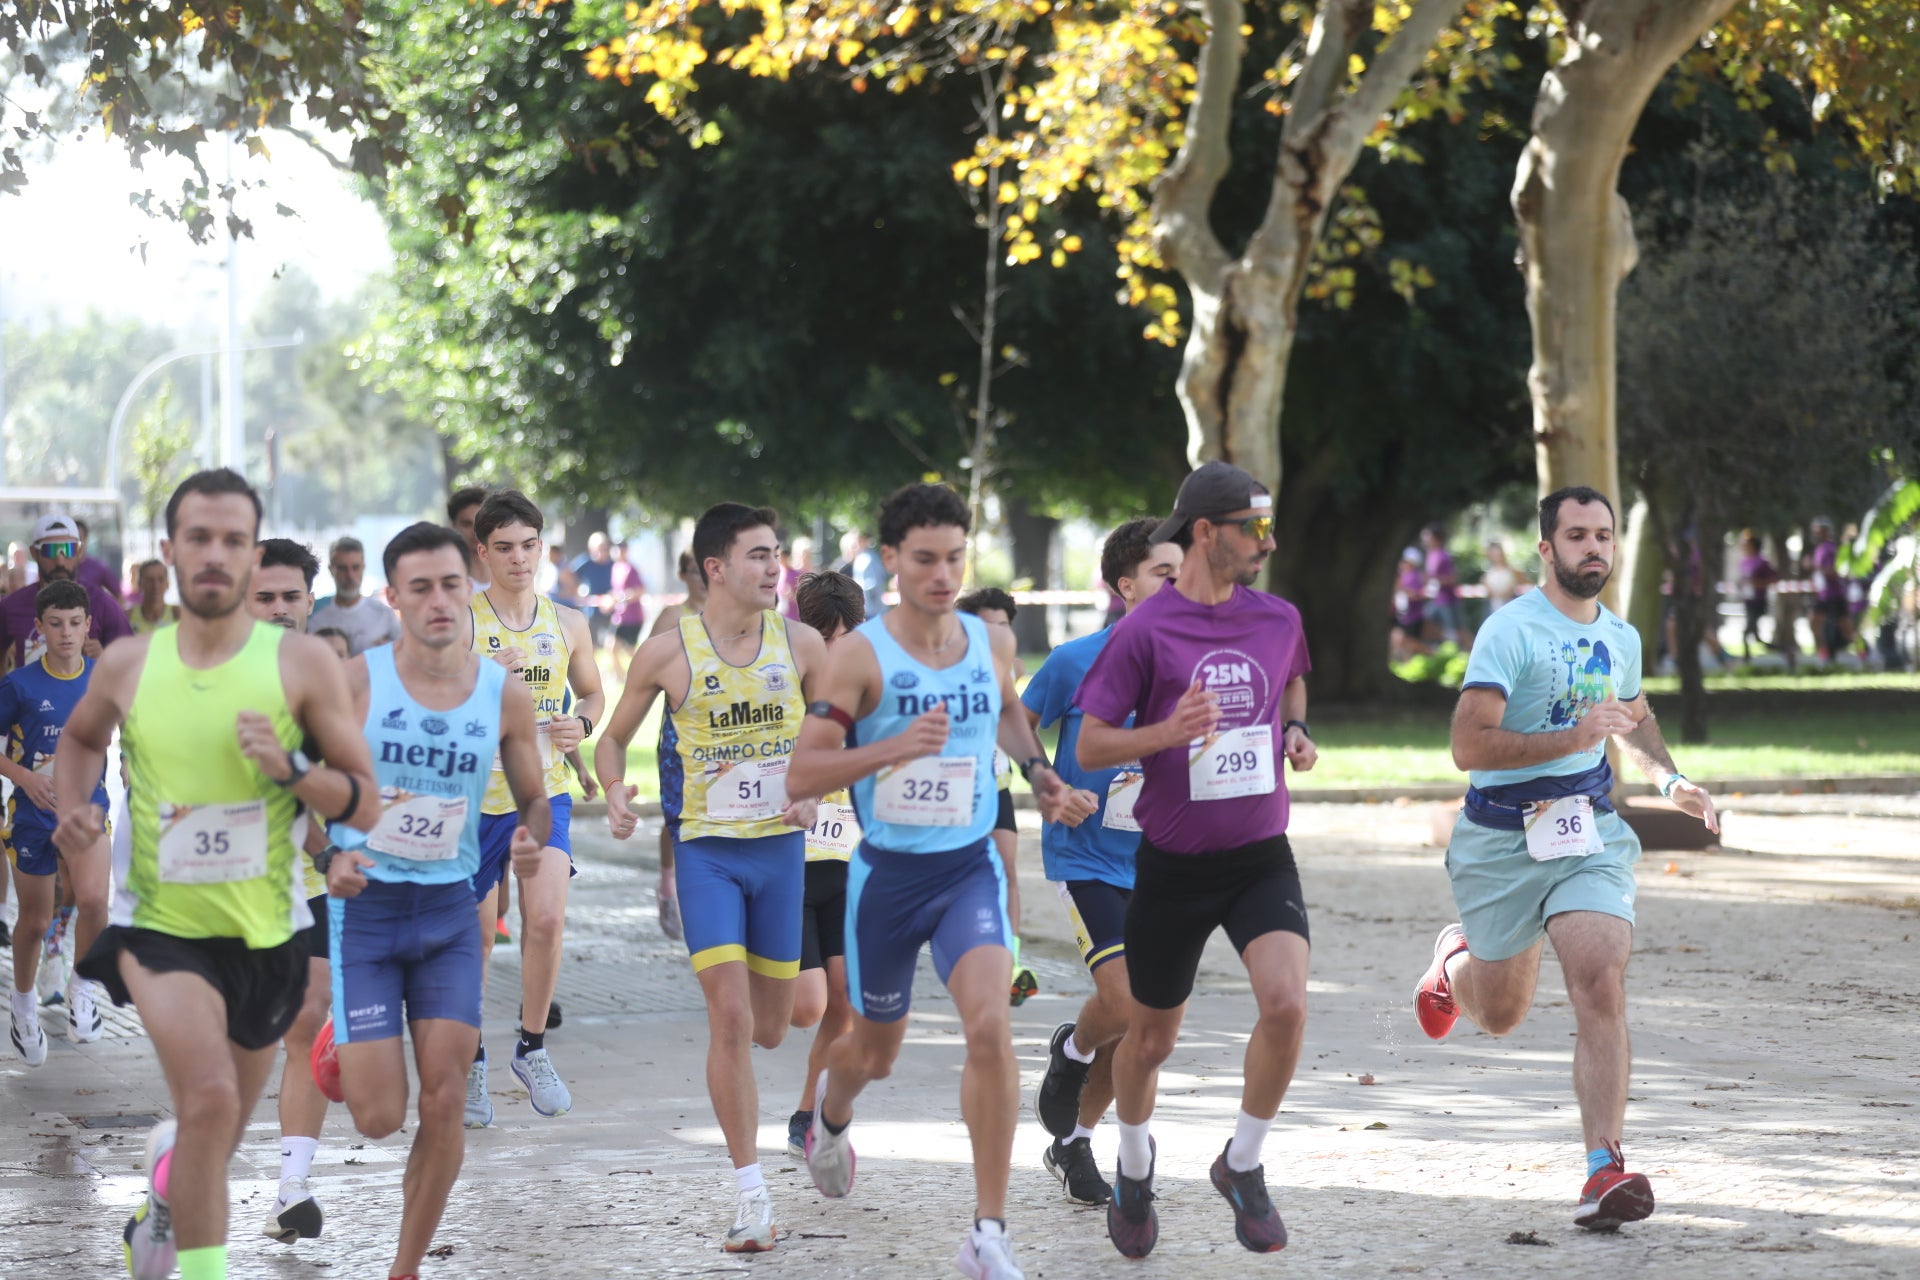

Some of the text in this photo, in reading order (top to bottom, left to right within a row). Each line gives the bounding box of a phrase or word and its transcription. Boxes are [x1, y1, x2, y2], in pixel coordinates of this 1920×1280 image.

[1203, 662, 1251, 686] 25N
[709, 701, 784, 729] LaMafia
[896, 683, 990, 723] nerja
[379, 740, 478, 778] nerja
[692, 735, 799, 761] OLIMPO CÁDI
[757, 759, 786, 769] CARRERA
[1216, 750, 1257, 775] 299
[392, 775, 463, 796] ATLETISMO
[738, 779, 761, 800] 51
[902, 778, 949, 802] 325
[399, 814, 444, 839] 324
[1556, 815, 1582, 836] 36
[195, 831, 230, 855] 35
[349, 1003, 387, 1018] nerja
